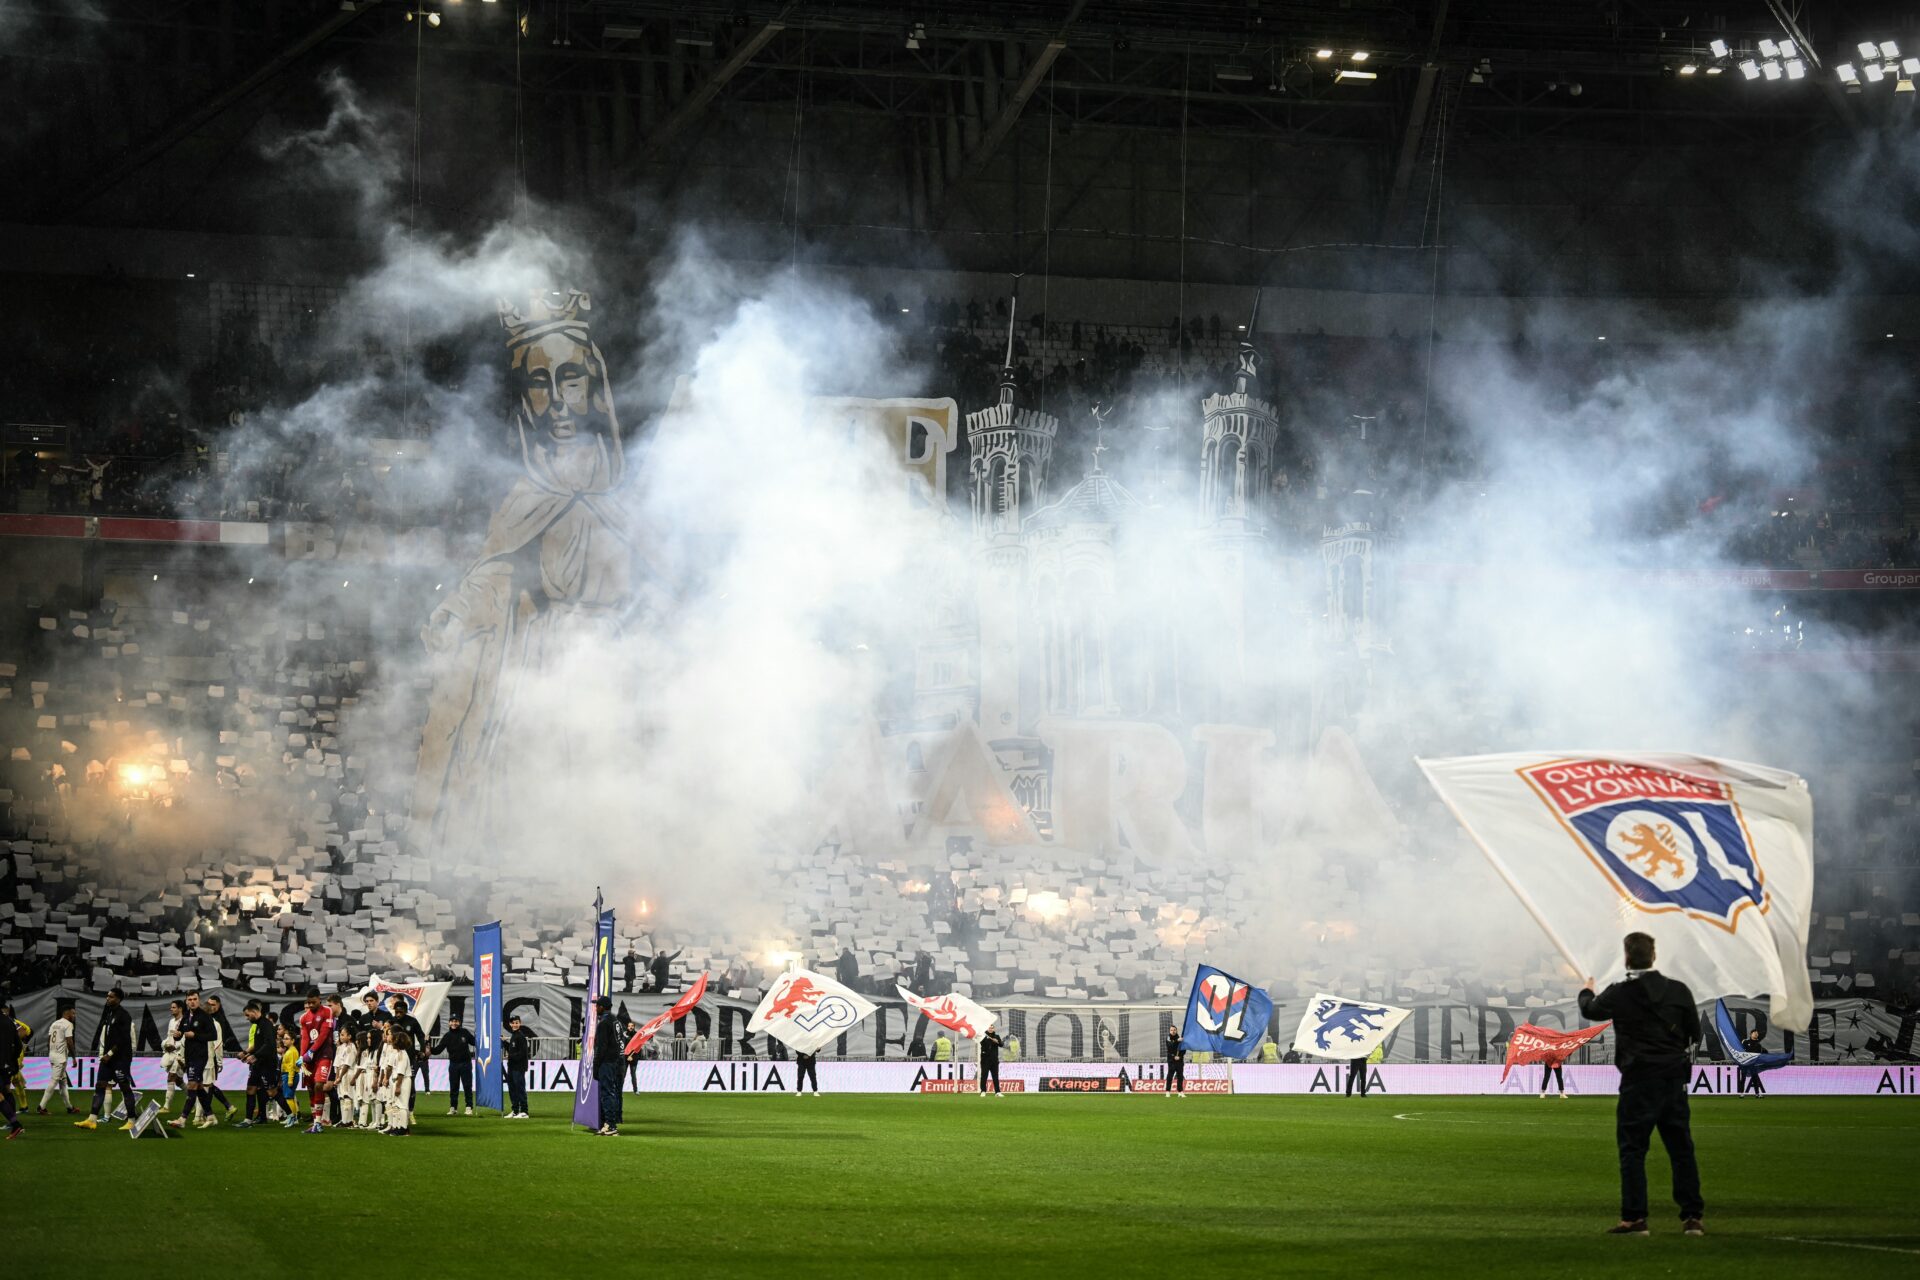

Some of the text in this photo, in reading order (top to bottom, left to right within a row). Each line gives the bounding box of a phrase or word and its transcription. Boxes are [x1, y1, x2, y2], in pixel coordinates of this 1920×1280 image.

[1196, 974, 1250, 1041] OL
[702, 1063, 786, 1091] AlilA
[1049, 1078, 1100, 1092] Orange
[1185, 1080, 1229, 1091] Betclic
